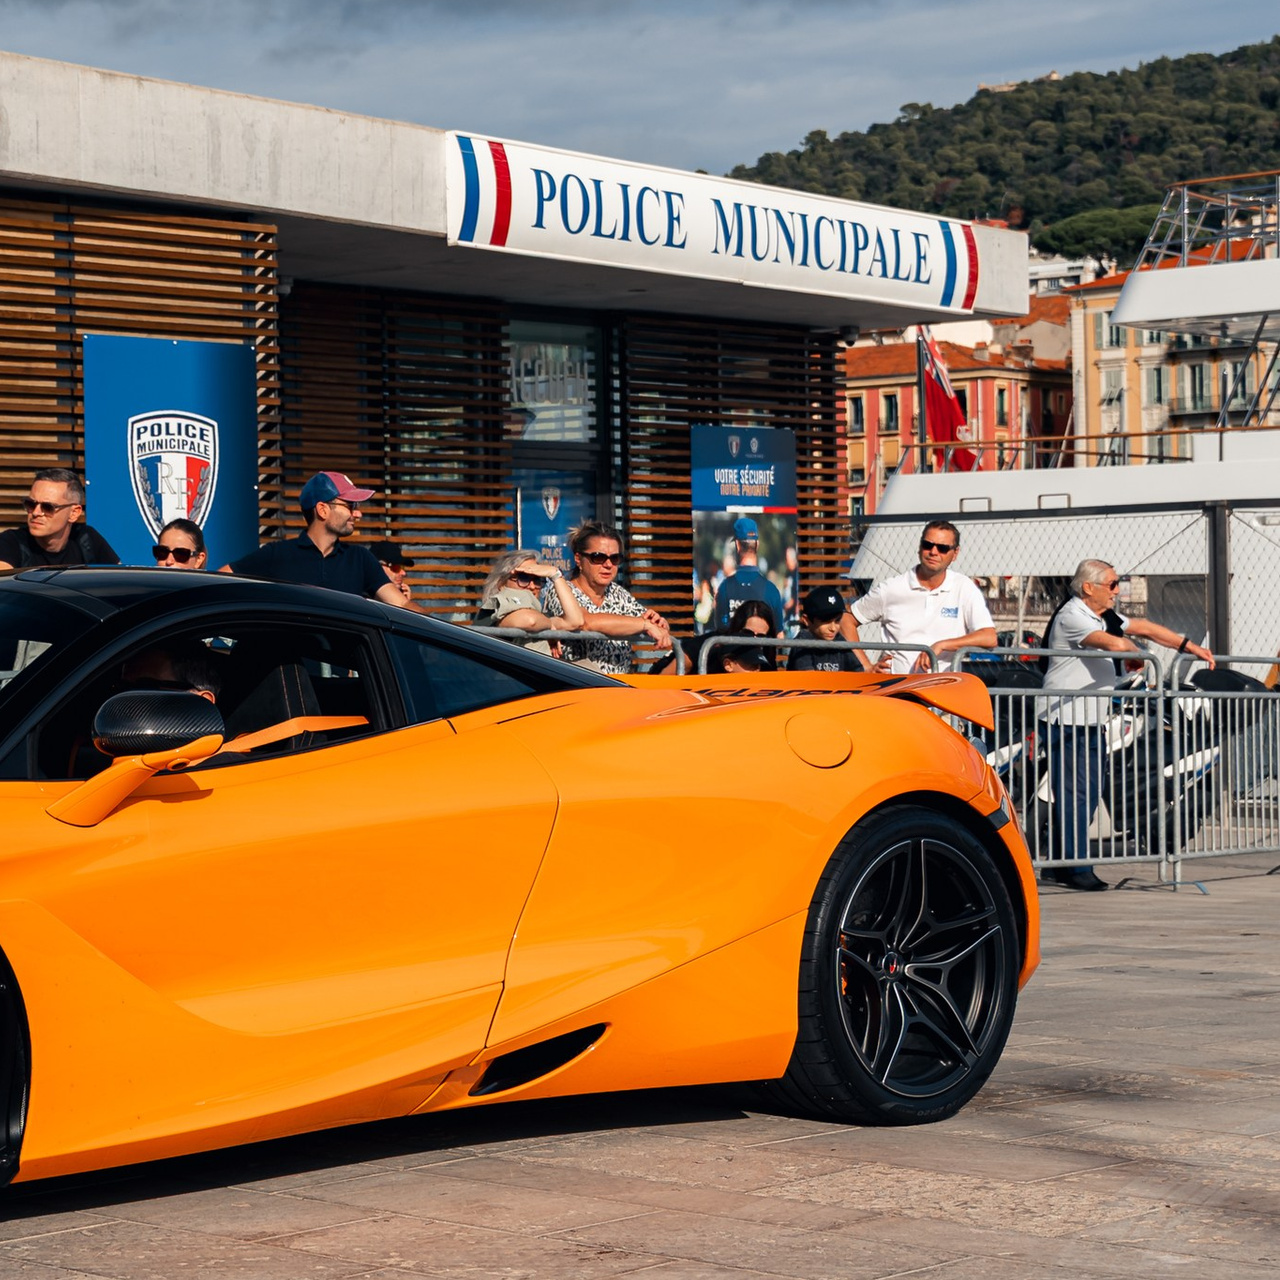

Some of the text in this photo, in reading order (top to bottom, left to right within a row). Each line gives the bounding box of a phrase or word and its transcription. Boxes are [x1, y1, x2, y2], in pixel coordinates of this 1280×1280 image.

[529, 167, 933, 285] POLICE MUNICIPALE
[136, 421, 210, 444] POLICE
[136, 437, 211, 457] MUNICIPALE
[714, 464, 775, 486] VOTRE SÉCURITÉ
[541, 547, 563, 560] POLICE
